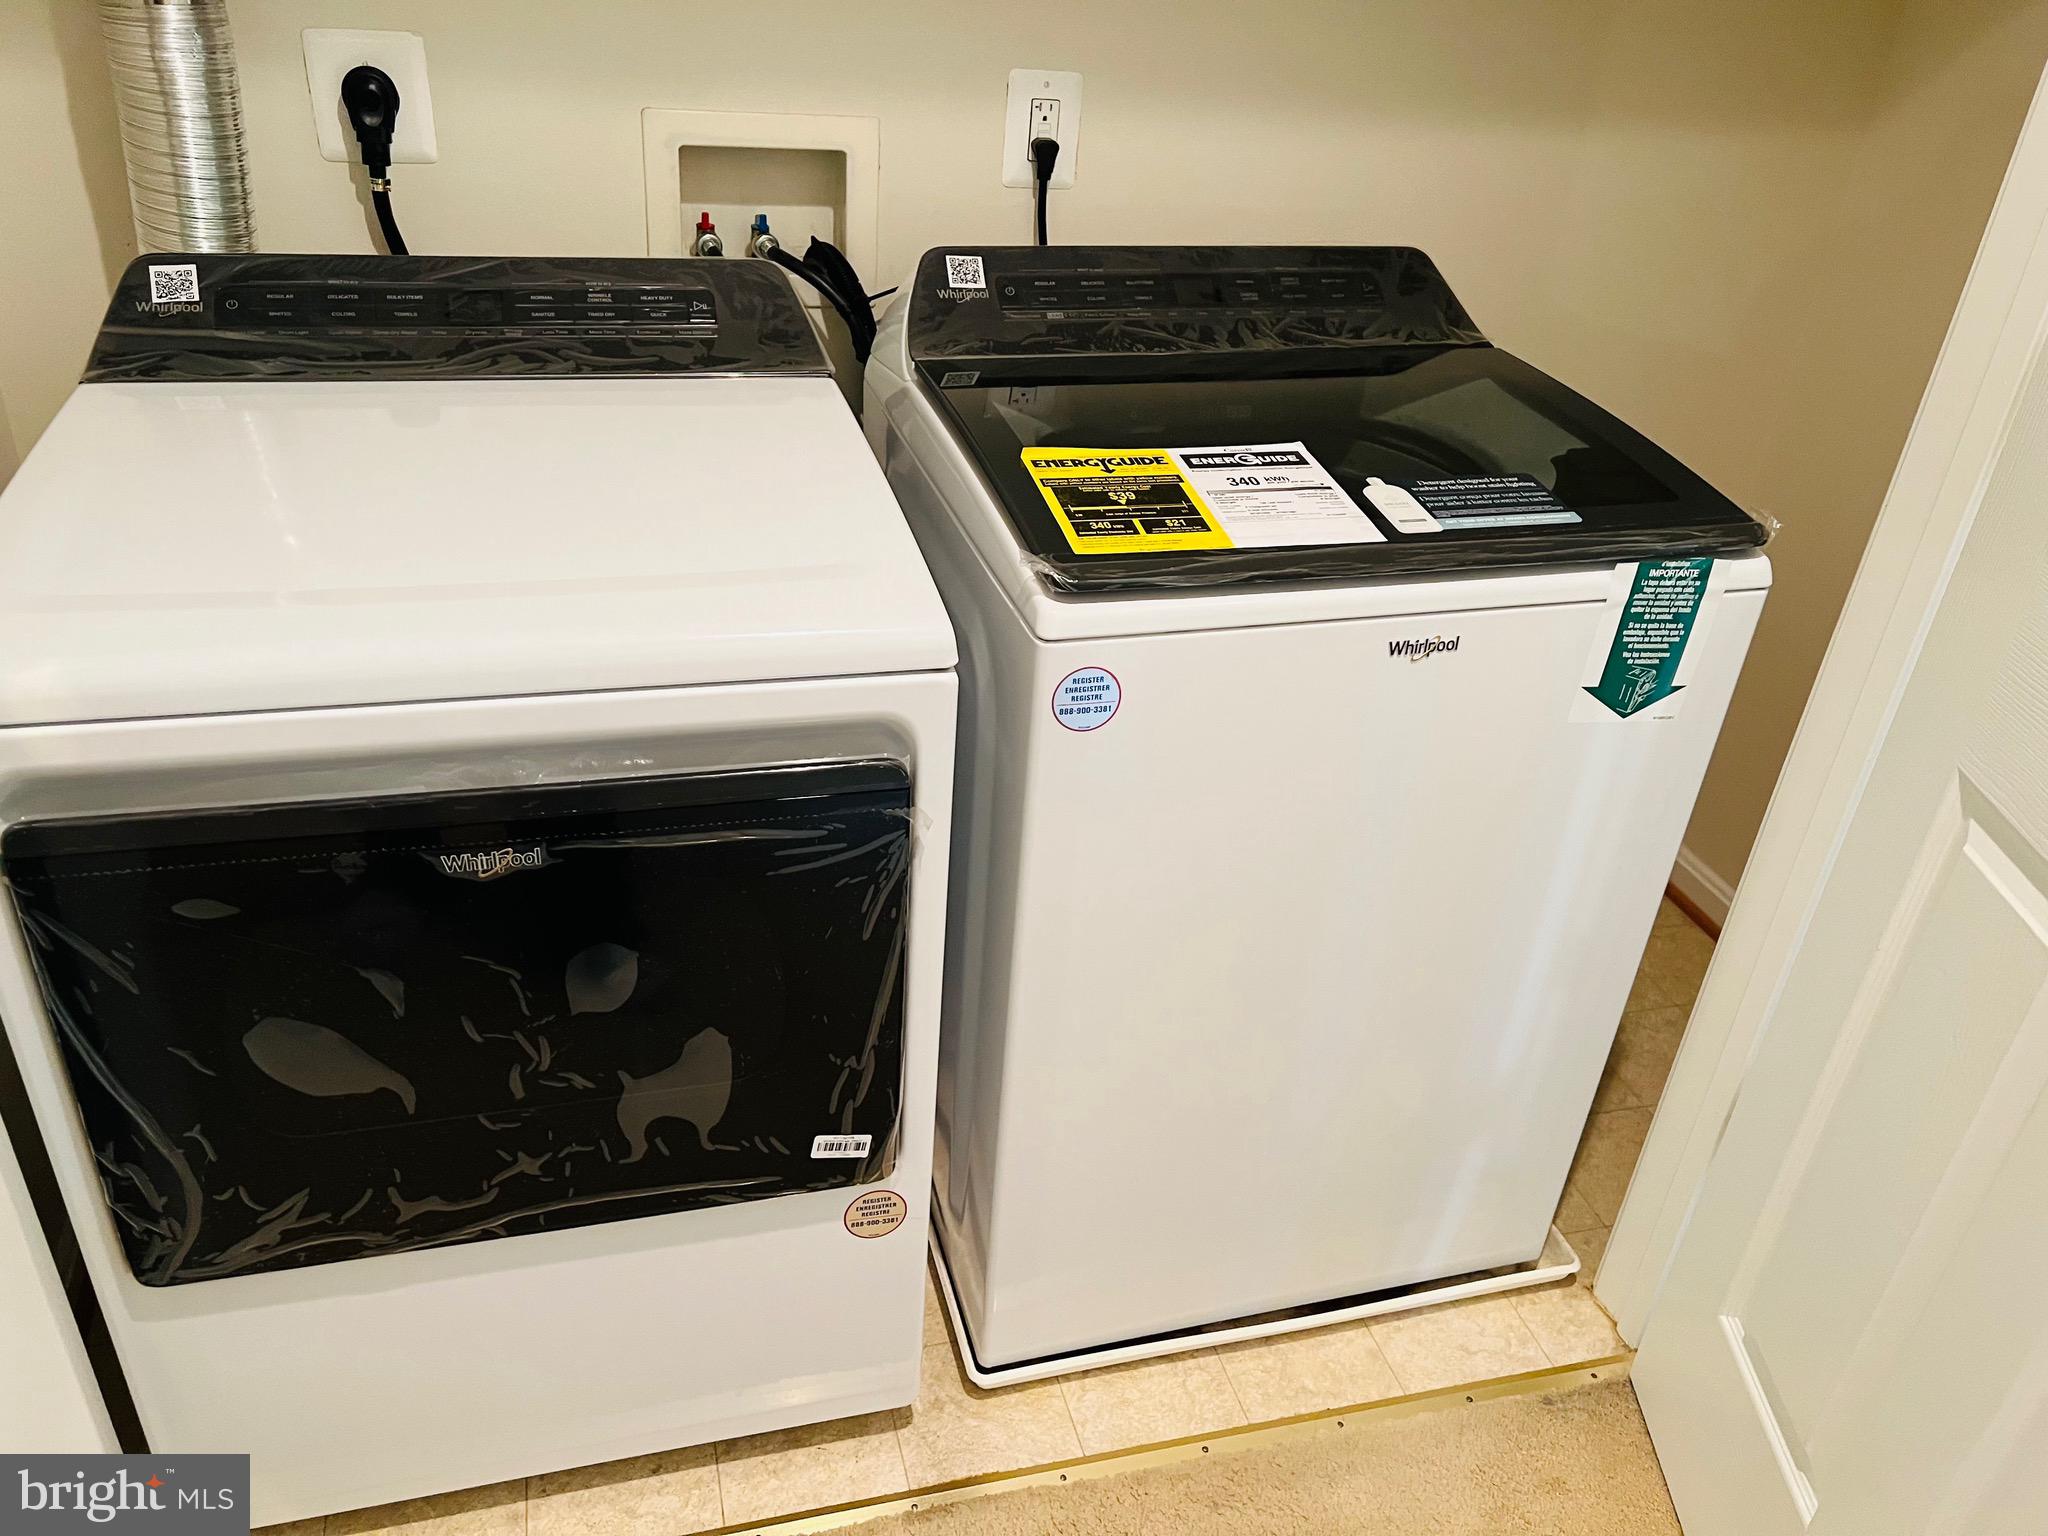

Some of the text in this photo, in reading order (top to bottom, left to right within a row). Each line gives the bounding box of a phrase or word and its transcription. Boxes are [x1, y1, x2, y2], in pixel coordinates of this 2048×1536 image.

[936, 288, 989, 303] Whirlpool
[135, 301, 203, 317] Whirlpool
[1226, 476, 1261, 486] 340
[1107, 491, 1136, 500] $39
[1089, 521, 1112, 529] 340
[1649, 569, 1700, 577] IMPORTANTE
[1389, 635, 1460, 659] Whirlpool
[1072, 676, 1105, 685] REGISTER
[1065, 684, 1110, 694] ENREGISTRER
[1071, 693, 1103, 702] REGISTRE
[1059, 705, 1112, 716] 888-900-3381
[440, 848, 541, 877] Whirlpool
[862, 1196, 892, 1204] REGISTER
[855, 1202, 897, 1212] ENREGISTRER
[861, 1209, 890, 1217] REGISTRE
